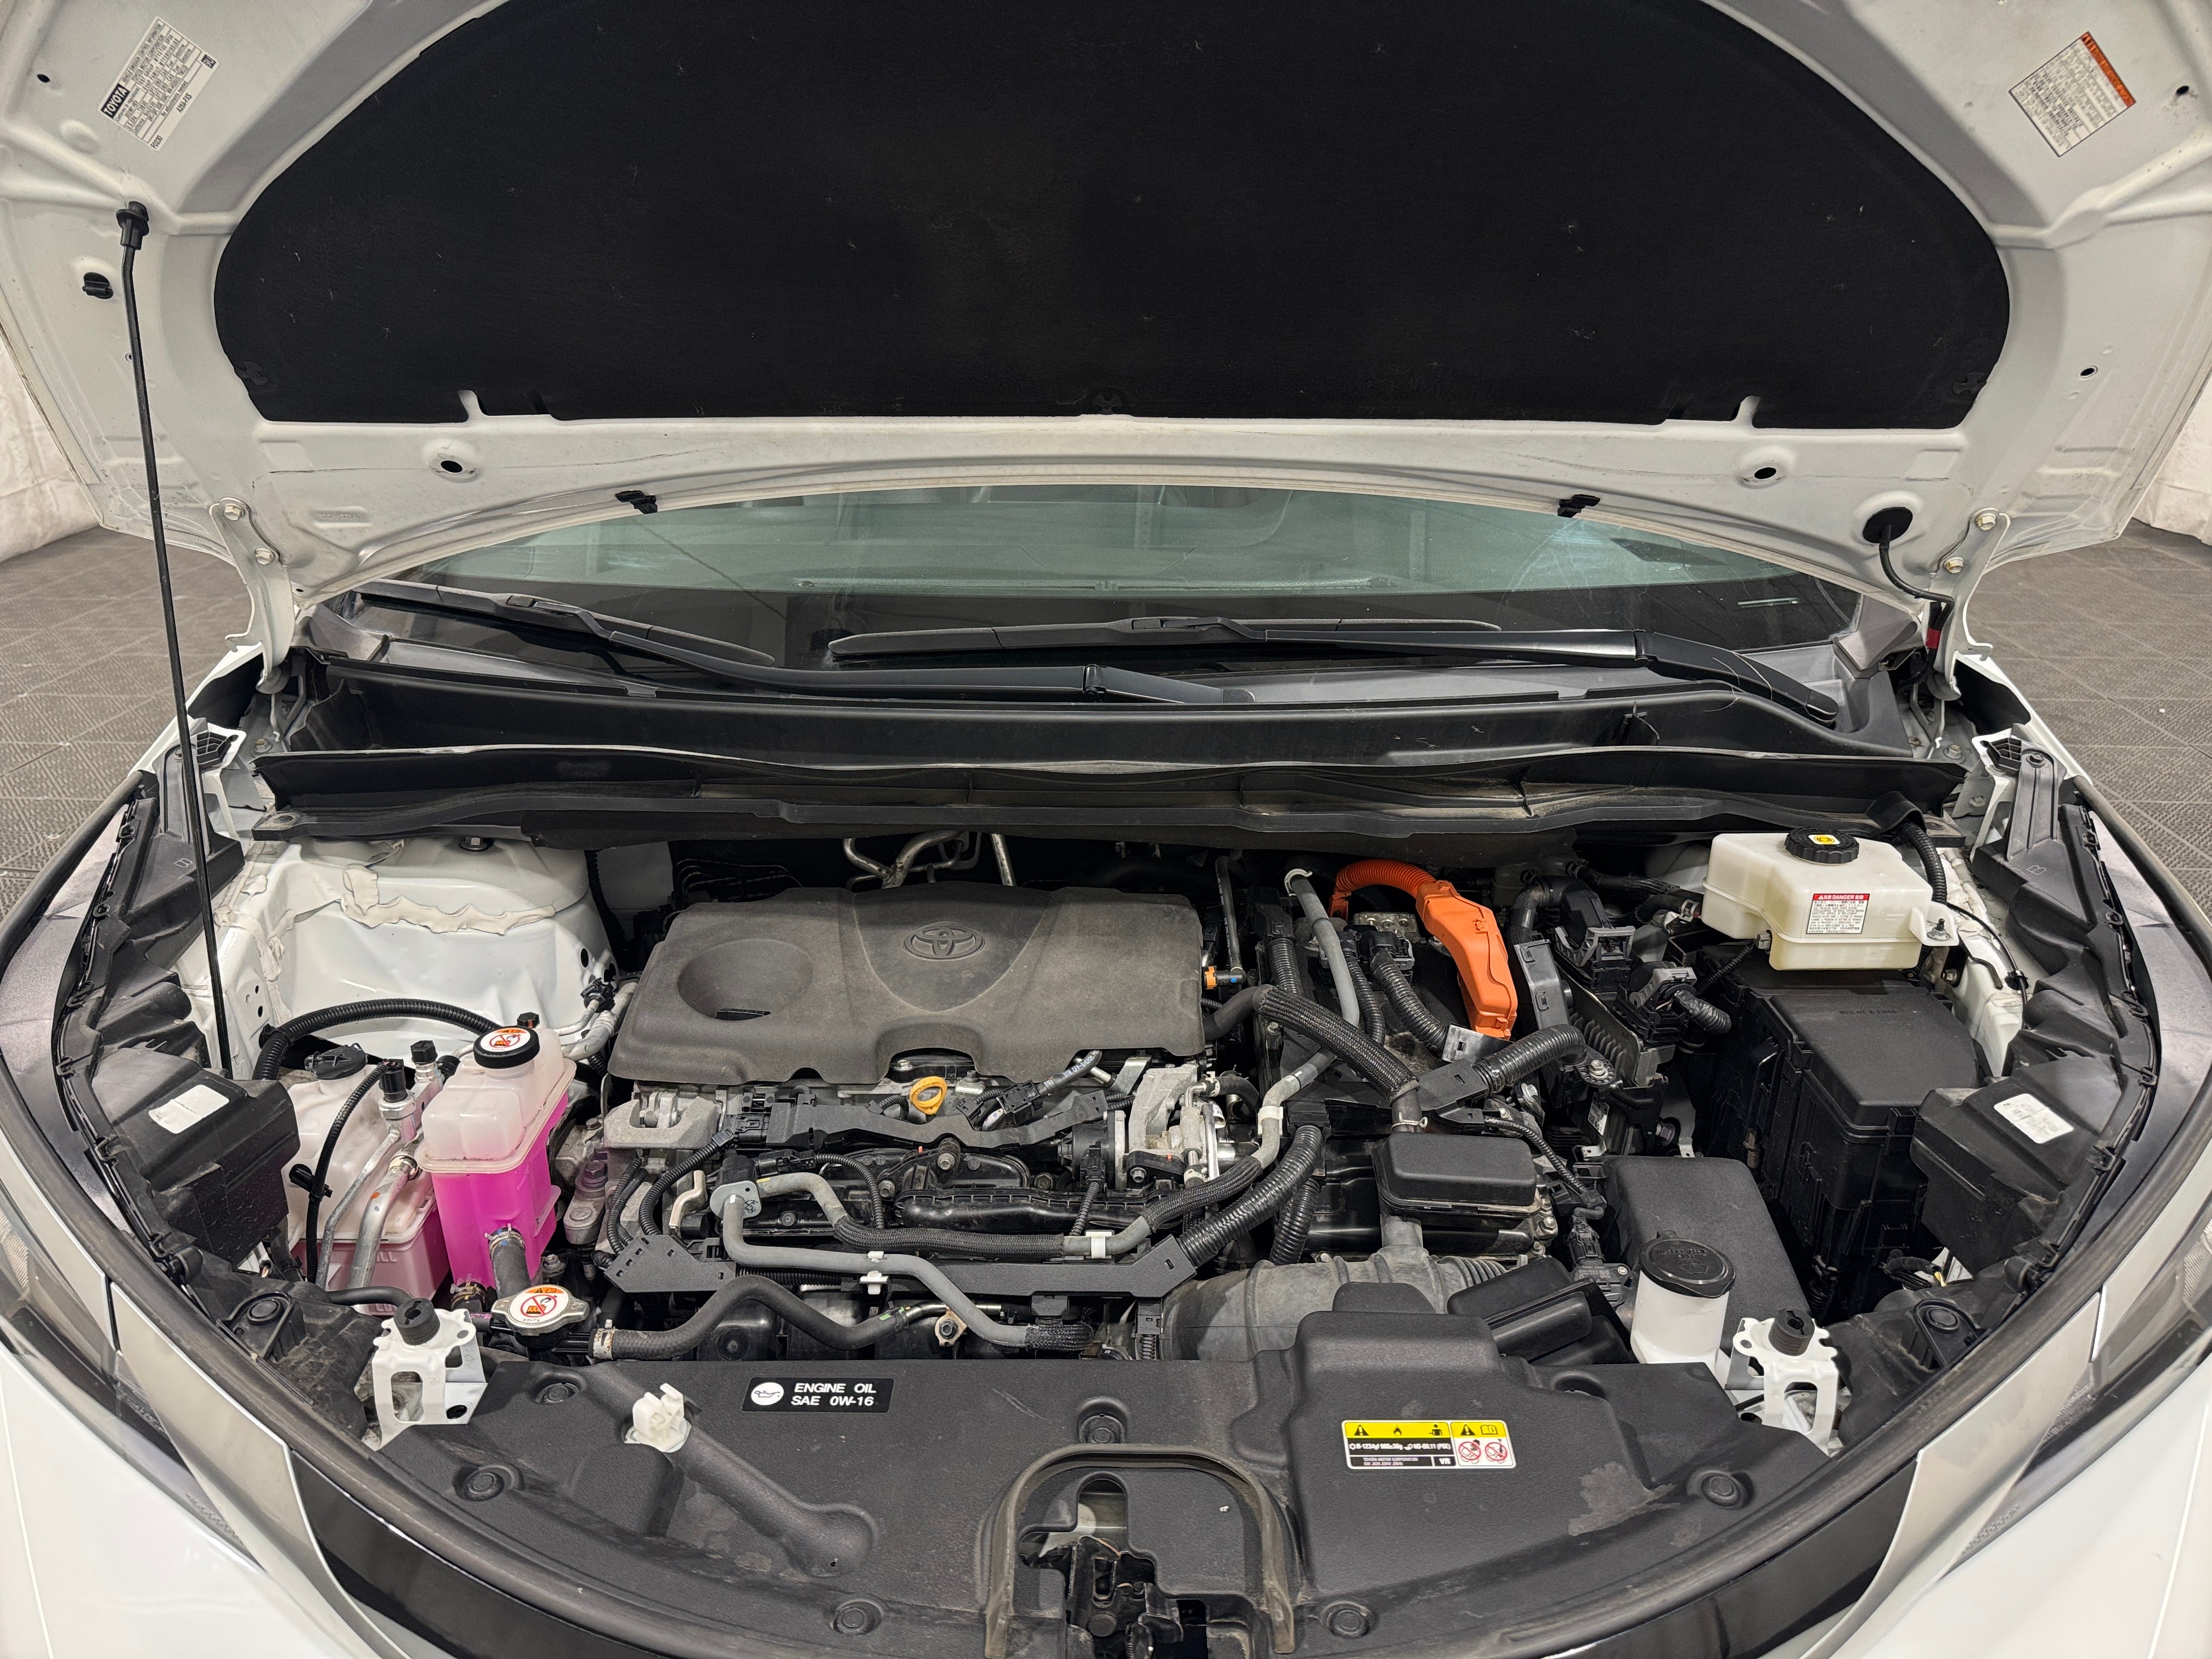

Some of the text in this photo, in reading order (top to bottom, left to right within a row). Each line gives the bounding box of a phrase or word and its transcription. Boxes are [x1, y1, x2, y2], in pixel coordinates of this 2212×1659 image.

[103, 84, 128, 117] TOYOTA
[794, 1383, 877, 1393] ENGINE OIL
[791, 1396, 874, 1406] SAE 0W-16
